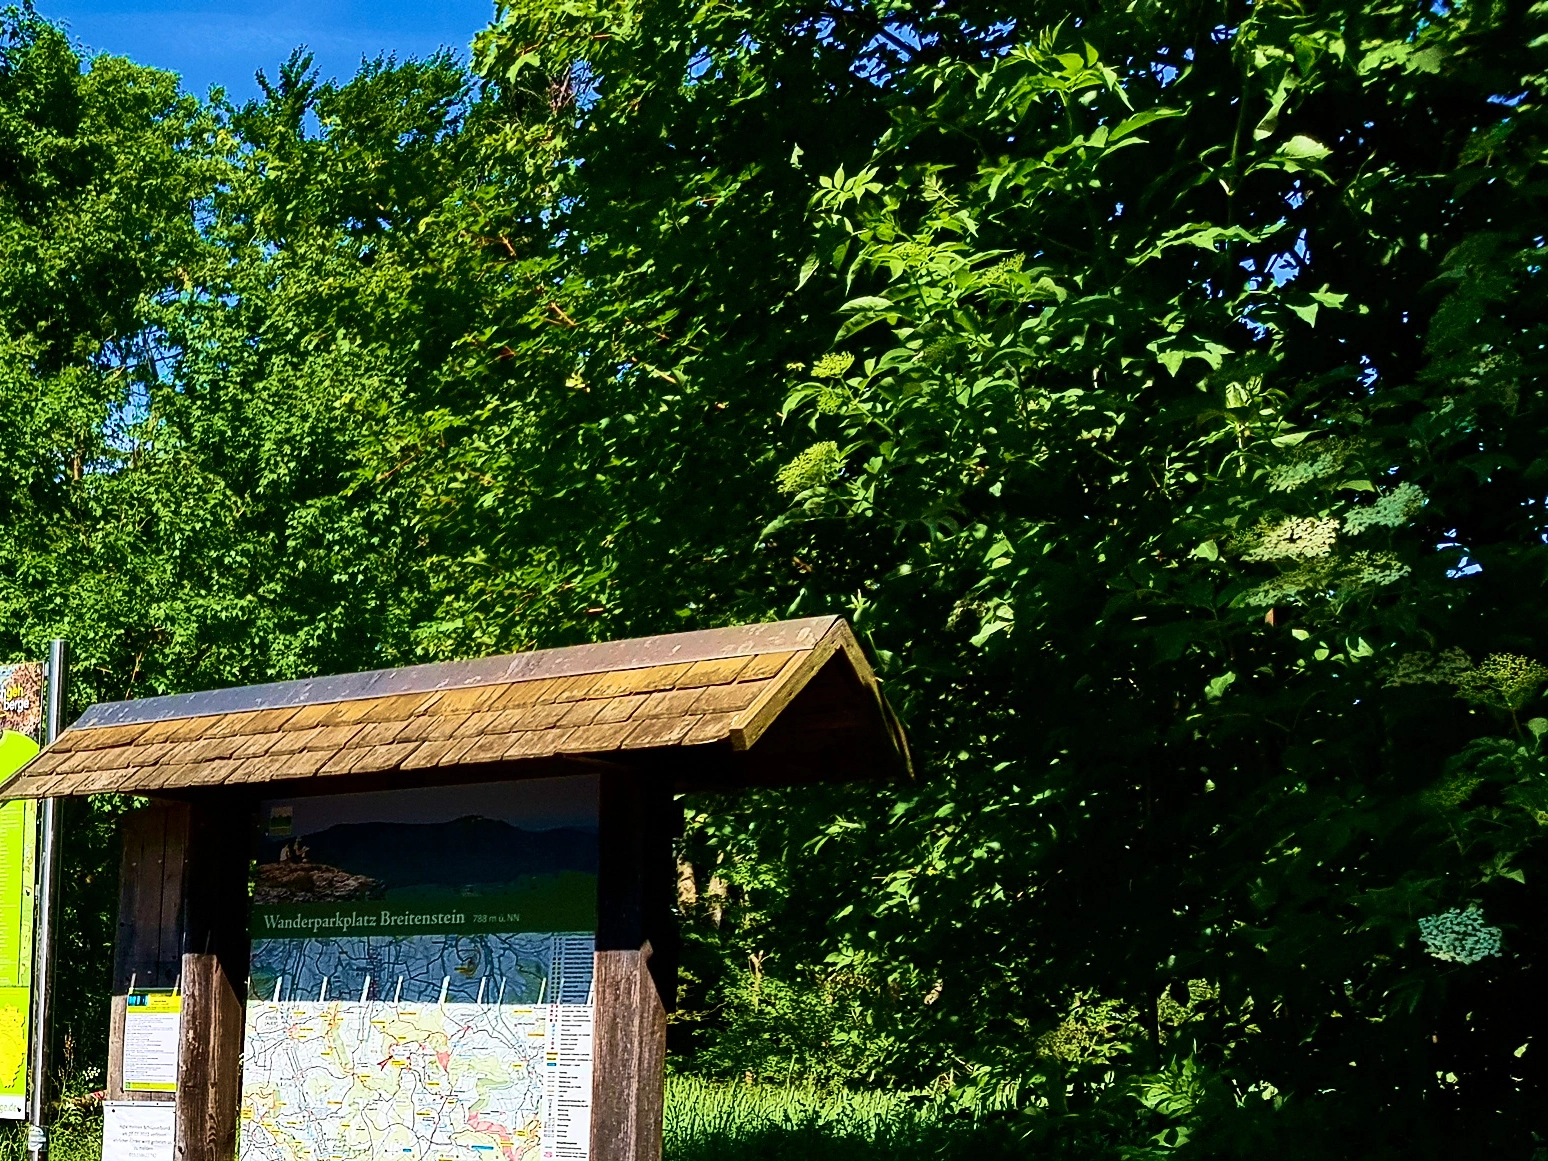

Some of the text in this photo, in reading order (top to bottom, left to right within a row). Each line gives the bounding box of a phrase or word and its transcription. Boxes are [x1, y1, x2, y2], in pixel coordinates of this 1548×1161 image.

[3, 699, 30, 713] berge
[263, 911, 377, 932] Wanderparkplatz
[379, 908, 466, 926] Breitenstein
[472, 914, 488, 923] 788
